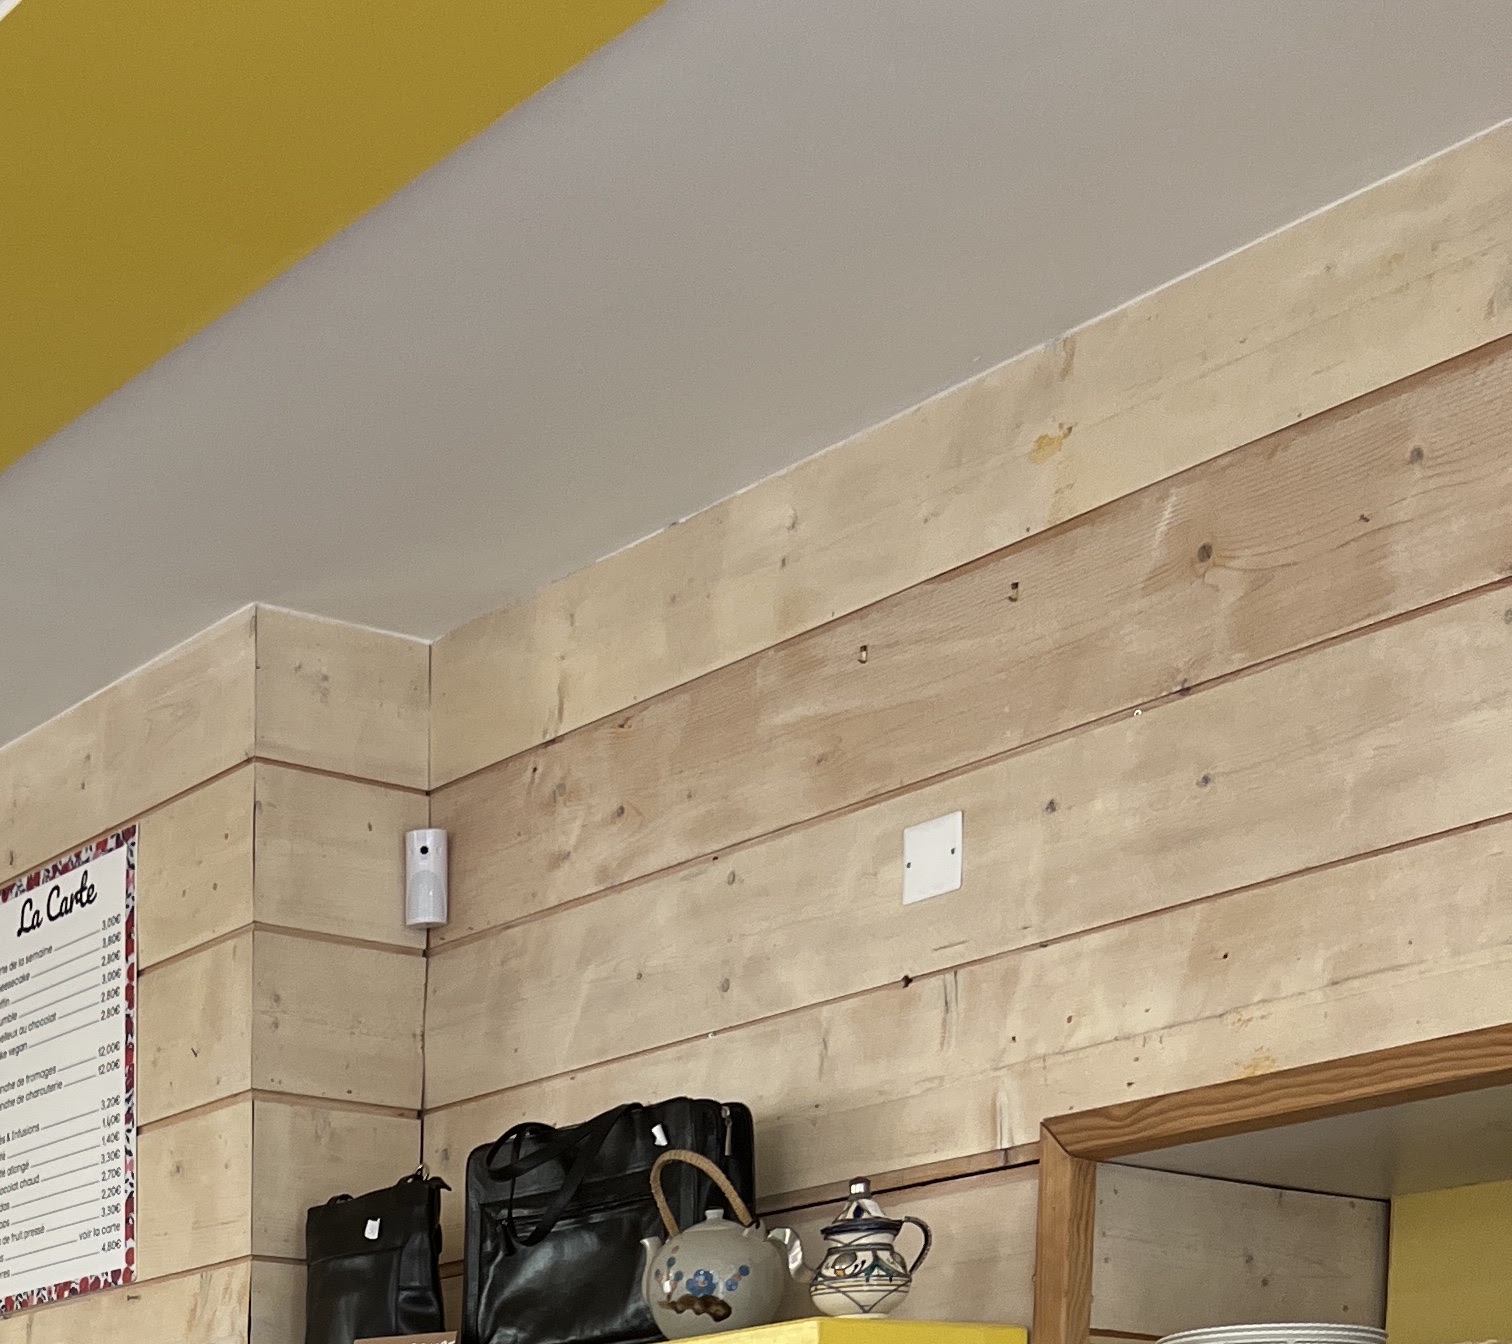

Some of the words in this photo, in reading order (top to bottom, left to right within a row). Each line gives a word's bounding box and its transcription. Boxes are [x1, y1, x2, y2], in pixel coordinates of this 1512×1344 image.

[17, 898, 43, 937] La
[47, 869, 98, 922] Carte
[28, 1012, 57, 1032] chocolat
[8, 1042, 28, 1057] vegan
[16, 1077, 25, 1088] de
[25, 1065, 57, 1084] fromages
[16, 1095, 25, 1105] de
[25, 1081, 63, 1101] charcuterie
[19, 1174, 40, 1190] chaud
[79, 1230, 92, 1240] voir
[93, 1227, 101, 1237] la
[101, 1222, 121, 1236] carte
